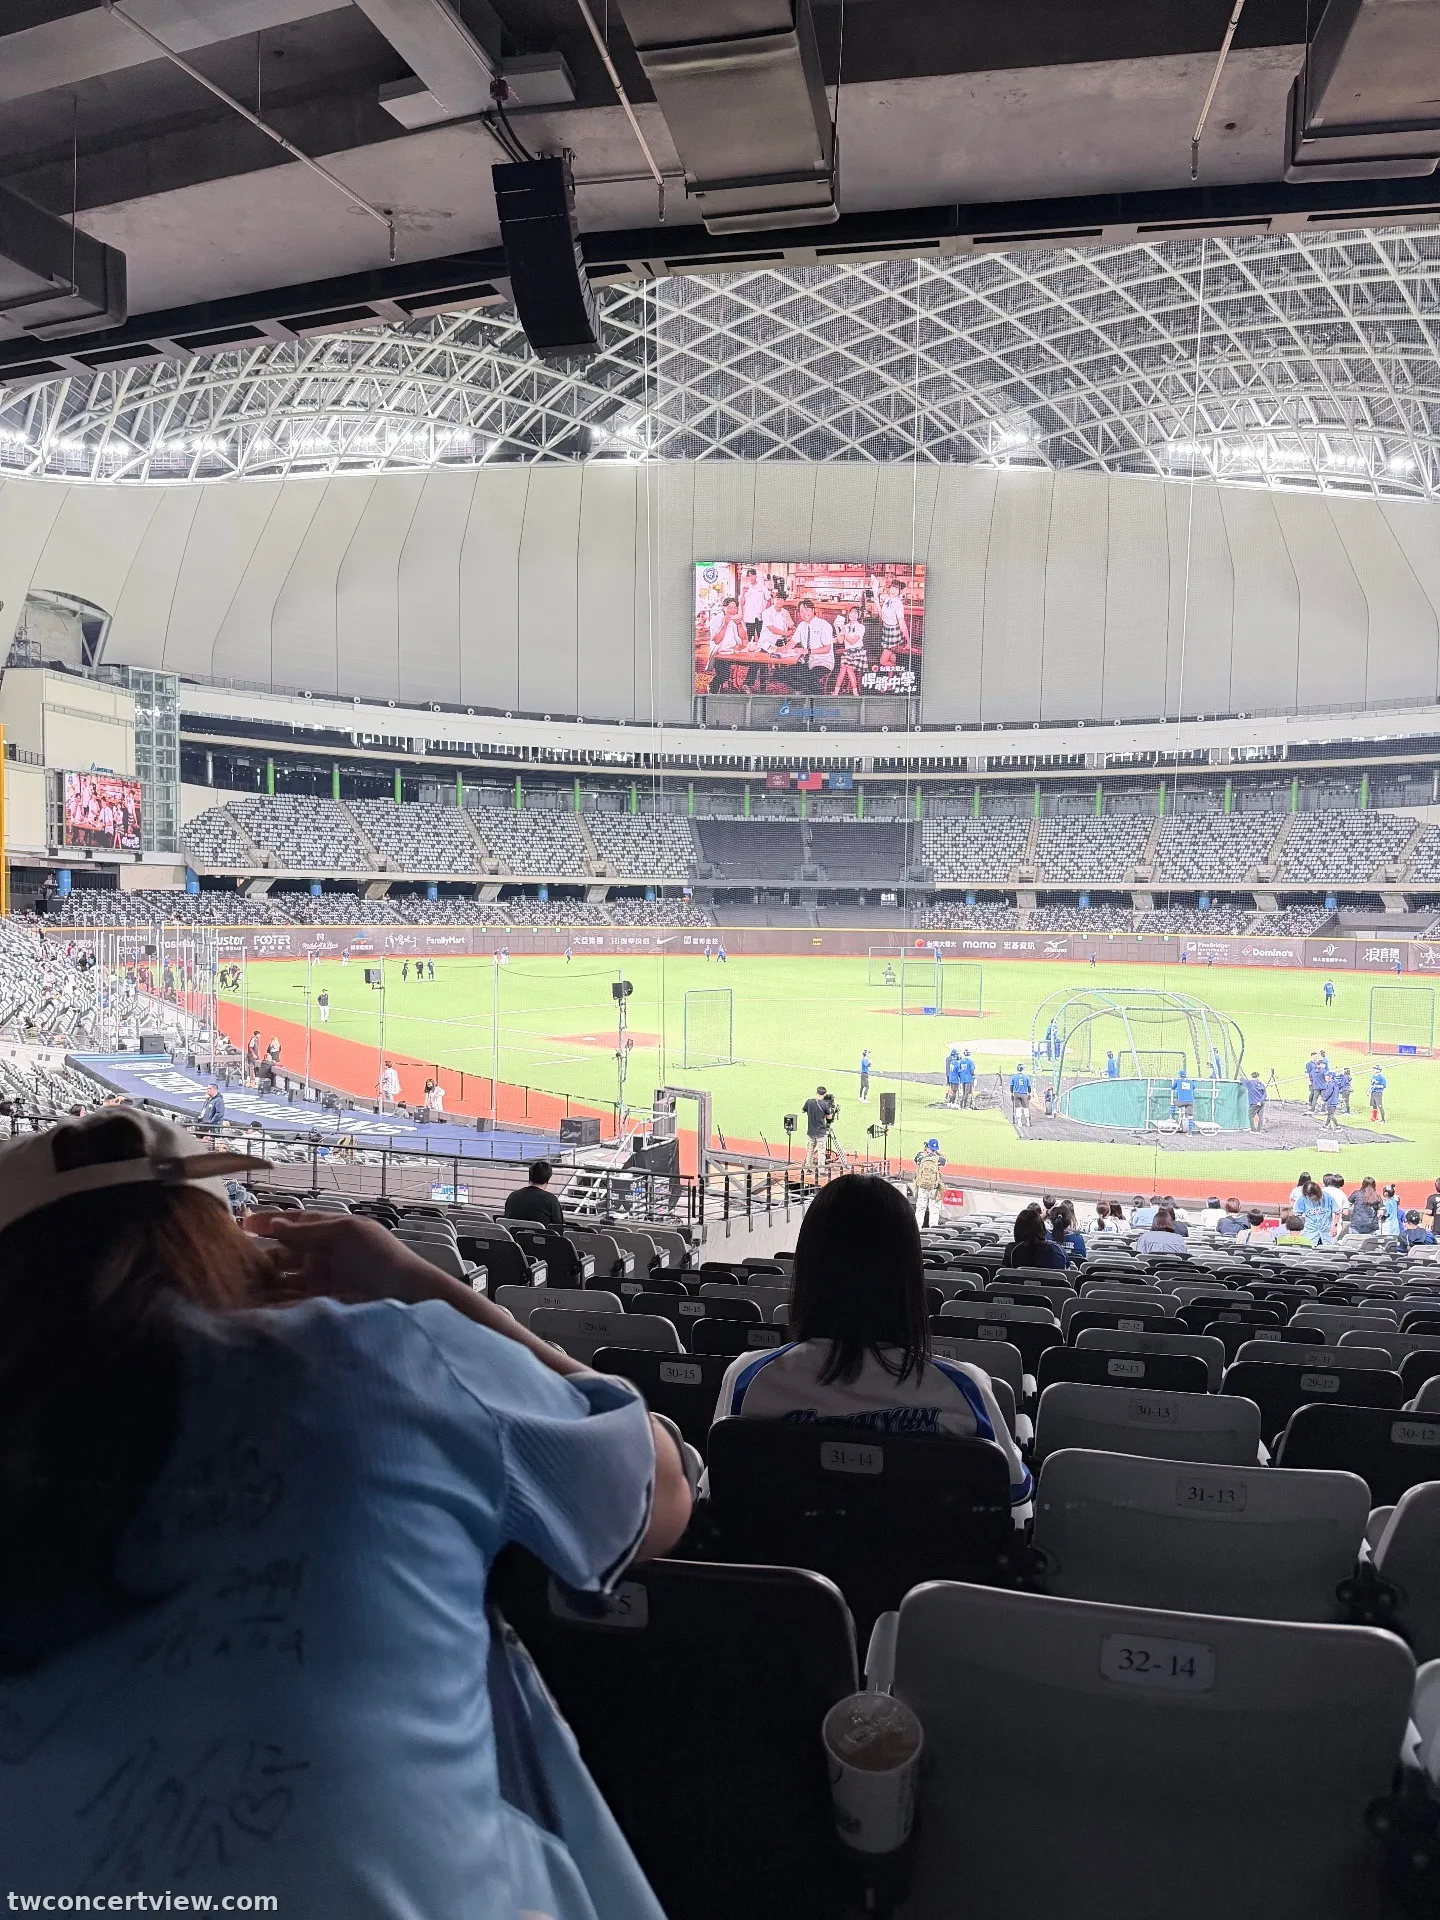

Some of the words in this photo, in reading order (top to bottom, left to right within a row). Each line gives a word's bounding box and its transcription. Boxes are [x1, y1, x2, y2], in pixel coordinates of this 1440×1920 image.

[427, 936, 466, 945] FamilyMart
[963, 941, 997, 949] momo
[1253, 948, 1294, 957] Domino's
[682, 1304, 701, 1313] 28-15
[752, 1333, 775, 1344] 29-15
[666, 1368, 695, 1379] 30-15
[1113, 1363, 1139, 1373] 29-13
[1306, 1379, 1334, 1389] 29-12
[1137, 1405, 1170, 1418] 30-13
[1398, 1427, 1436, 1440] 30-12
[831, 1451, 873, 1466] 31-14
[1188, 1486, 1236, 1503] 31-13
[1118, 1648, 1197, 1678] 32-14
